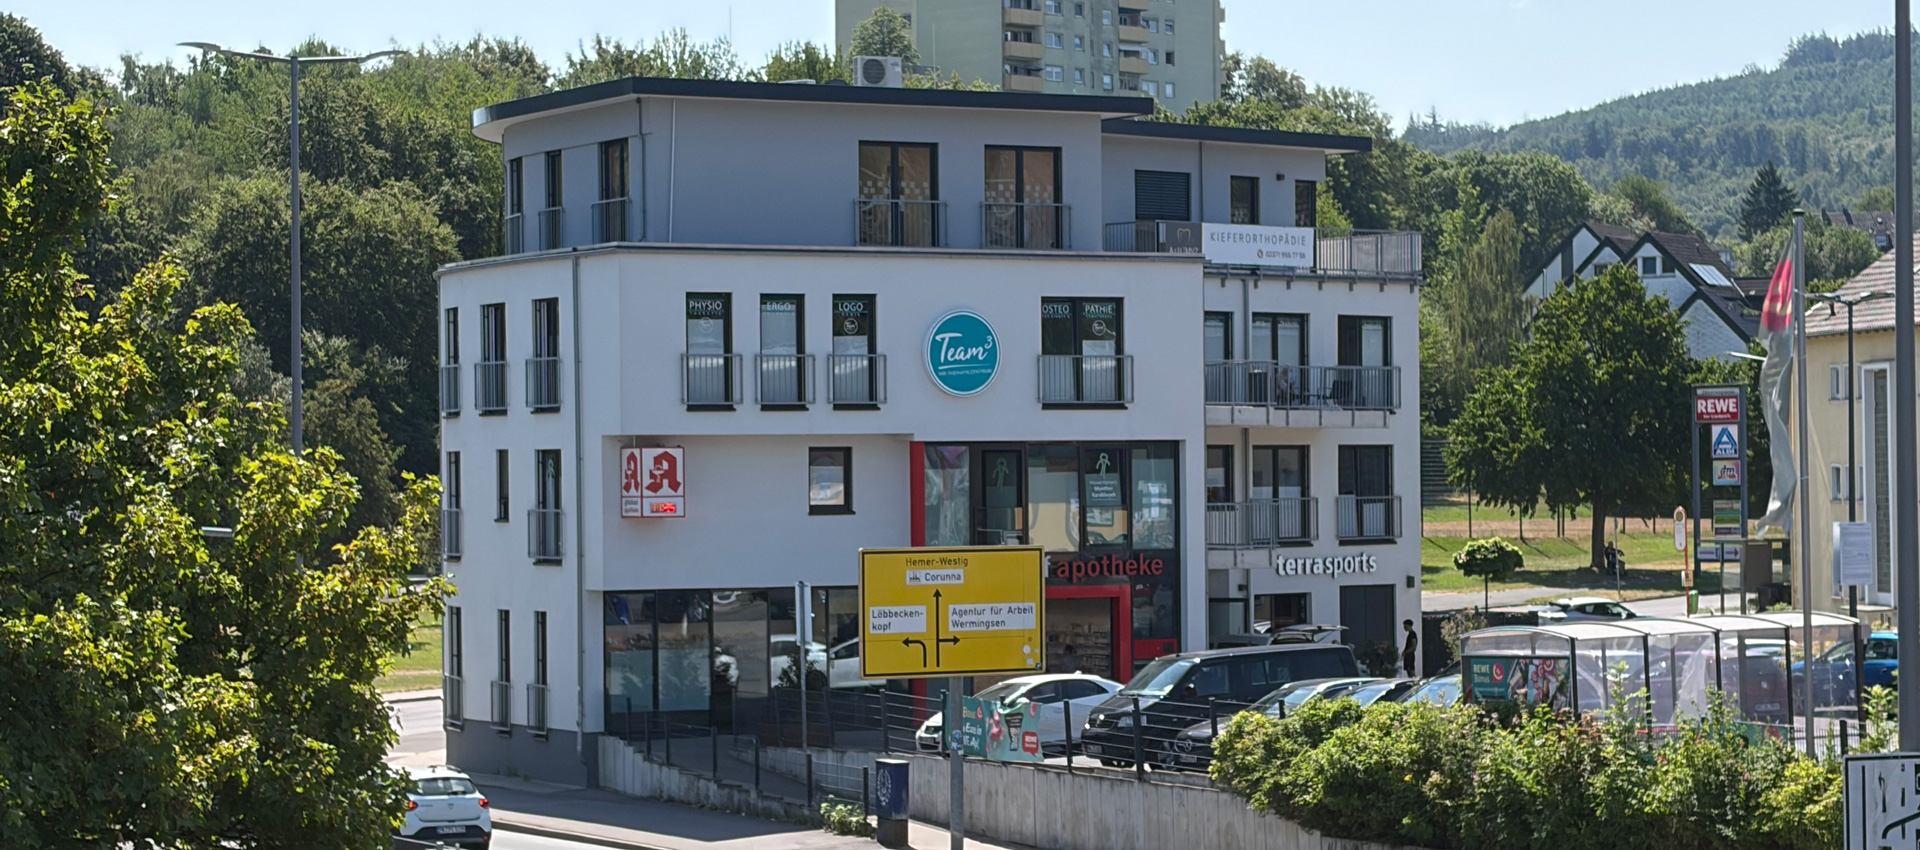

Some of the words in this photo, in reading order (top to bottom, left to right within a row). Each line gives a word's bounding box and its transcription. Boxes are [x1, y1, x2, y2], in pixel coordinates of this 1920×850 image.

[1210, 232, 1306, 247] KIEFERORTHOPÄDIE
[689, 300, 722, 310] PHYSIO
[766, 302, 791, 311] ERGO
[838, 302, 863, 312] LOGO
[1042, 304, 1070, 314] OSTEO
[1085, 304, 1112, 314] PATHIE
[1697, 398, 1737, 413] REWE
[1721, 465, 1735, 477] dm
[905, 556, 969, 568] Hemer-Westig
[1057, 553, 1163, 583] apotheke
[1276, 552, 1377, 579] terrasports
[924, 572, 962, 582] Corunna
[871, 608, 924, 619] Löbbecken-
[951, 606, 986, 617] Agentur
[990, 605, 1003, 615] für
[1007, 605, 1034, 615] Arbeit
[871, 621, 892, 633] kopf
[951, 619, 1006, 631] Wermingsen
